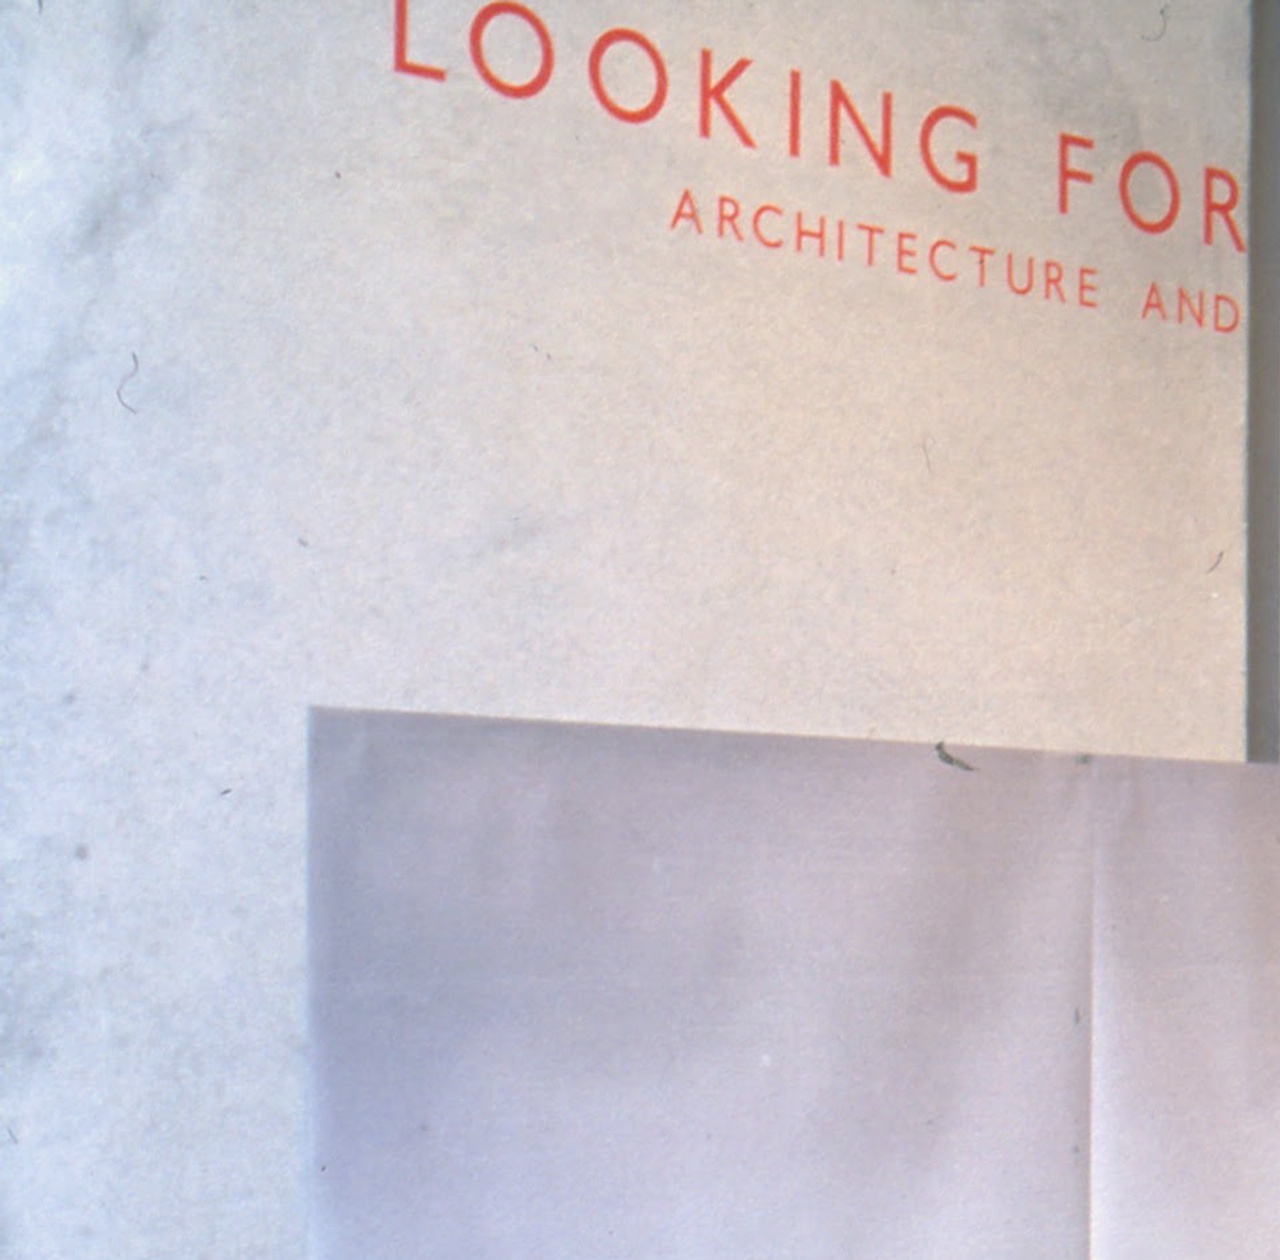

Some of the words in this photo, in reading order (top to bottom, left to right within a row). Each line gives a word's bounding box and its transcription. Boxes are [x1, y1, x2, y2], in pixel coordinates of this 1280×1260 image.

[392, 0, 980, 197] LOOKING
[1056, 131, 1247, 254] FOR
[668, 187, 1100, 310] ARCHITECTURE
[1139, 282, 1243, 335] AND
